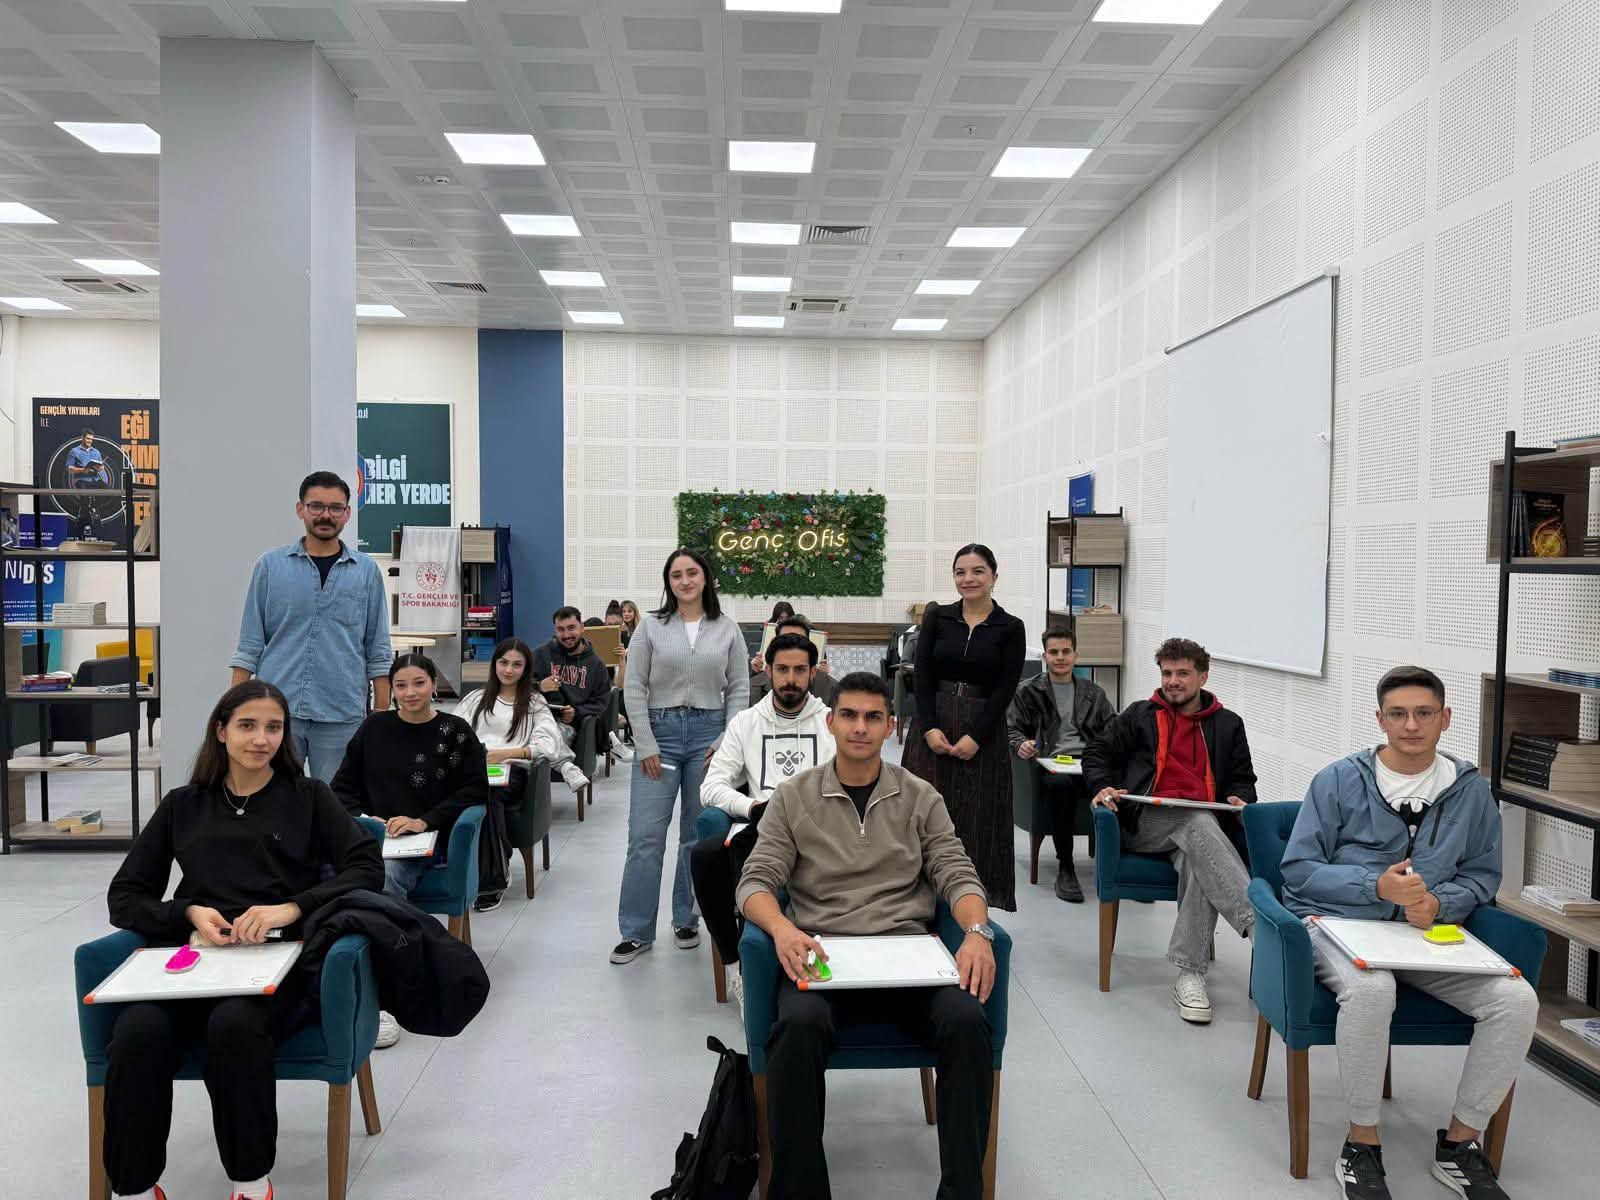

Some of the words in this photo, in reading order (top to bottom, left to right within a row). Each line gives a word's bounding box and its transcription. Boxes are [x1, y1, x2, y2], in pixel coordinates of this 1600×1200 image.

[40, 404, 66, 416] GENÇLİK
[67, 406, 100, 416] YAYINLARI
[40, 417, 49, 427] İLE
[121, 410, 150, 440] EĞİ
[364, 454, 407, 481] BİLGİ
[364, 482, 397, 505] HER
[400, 483, 451, 505] YERDE
[718, 530, 785, 553] Genç
[798, 528, 846, 551] Ofis
